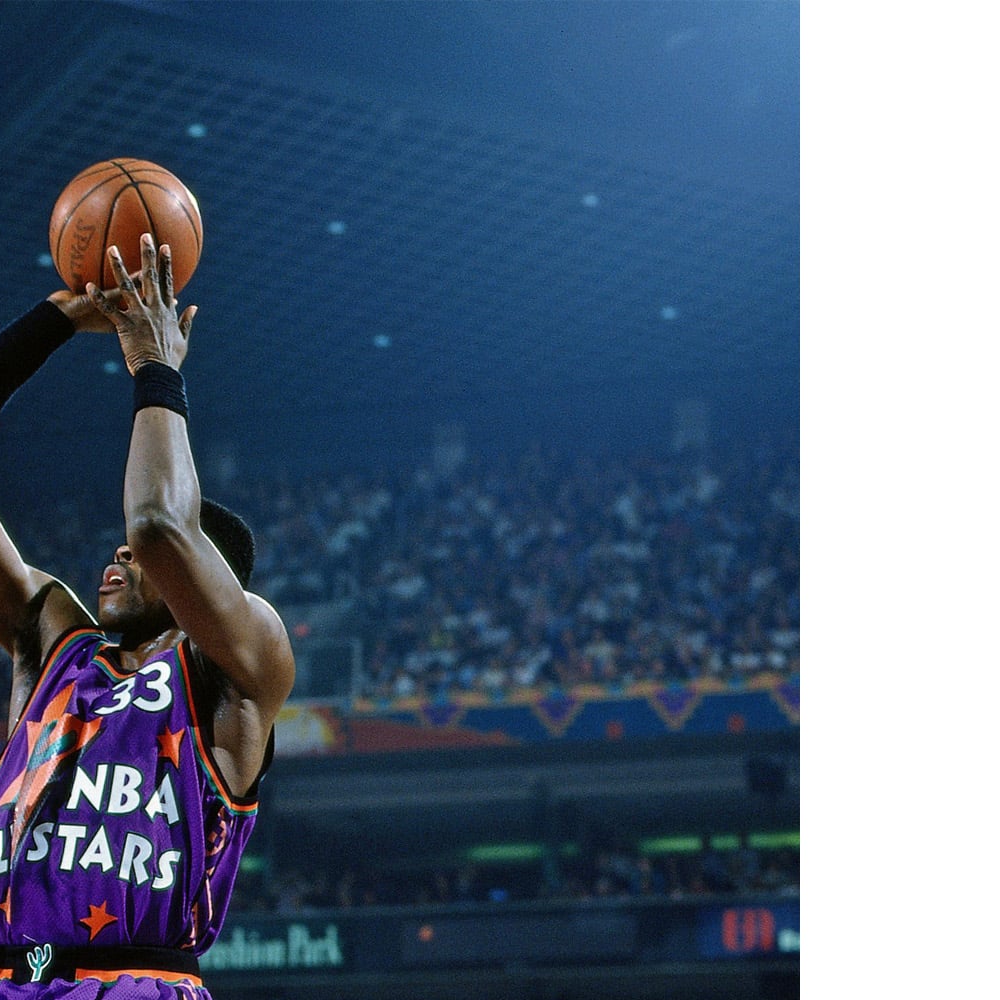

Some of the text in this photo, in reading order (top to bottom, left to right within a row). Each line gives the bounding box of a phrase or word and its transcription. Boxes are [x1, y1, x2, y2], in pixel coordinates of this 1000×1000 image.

[94, 661, 173, 715] 33
[66, 764, 181, 826] NBA
[26, 821, 182, 890] STARS
